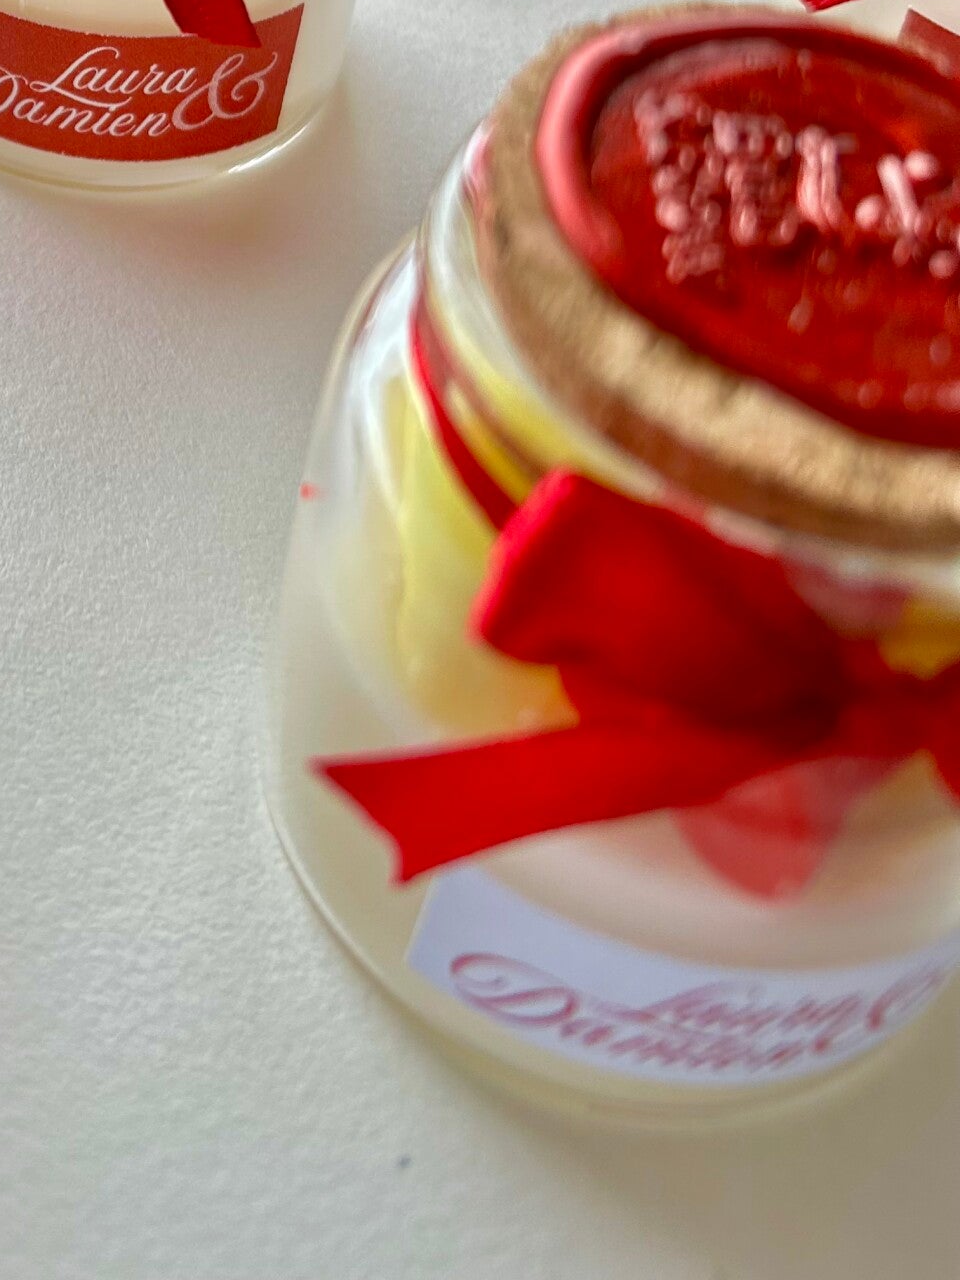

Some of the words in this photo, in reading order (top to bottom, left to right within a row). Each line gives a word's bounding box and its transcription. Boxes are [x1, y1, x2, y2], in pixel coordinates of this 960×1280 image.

[29, 46, 199, 108] Laura
[171, 51, 278, 131] &
[448, 951, 808, 1072] Damien
